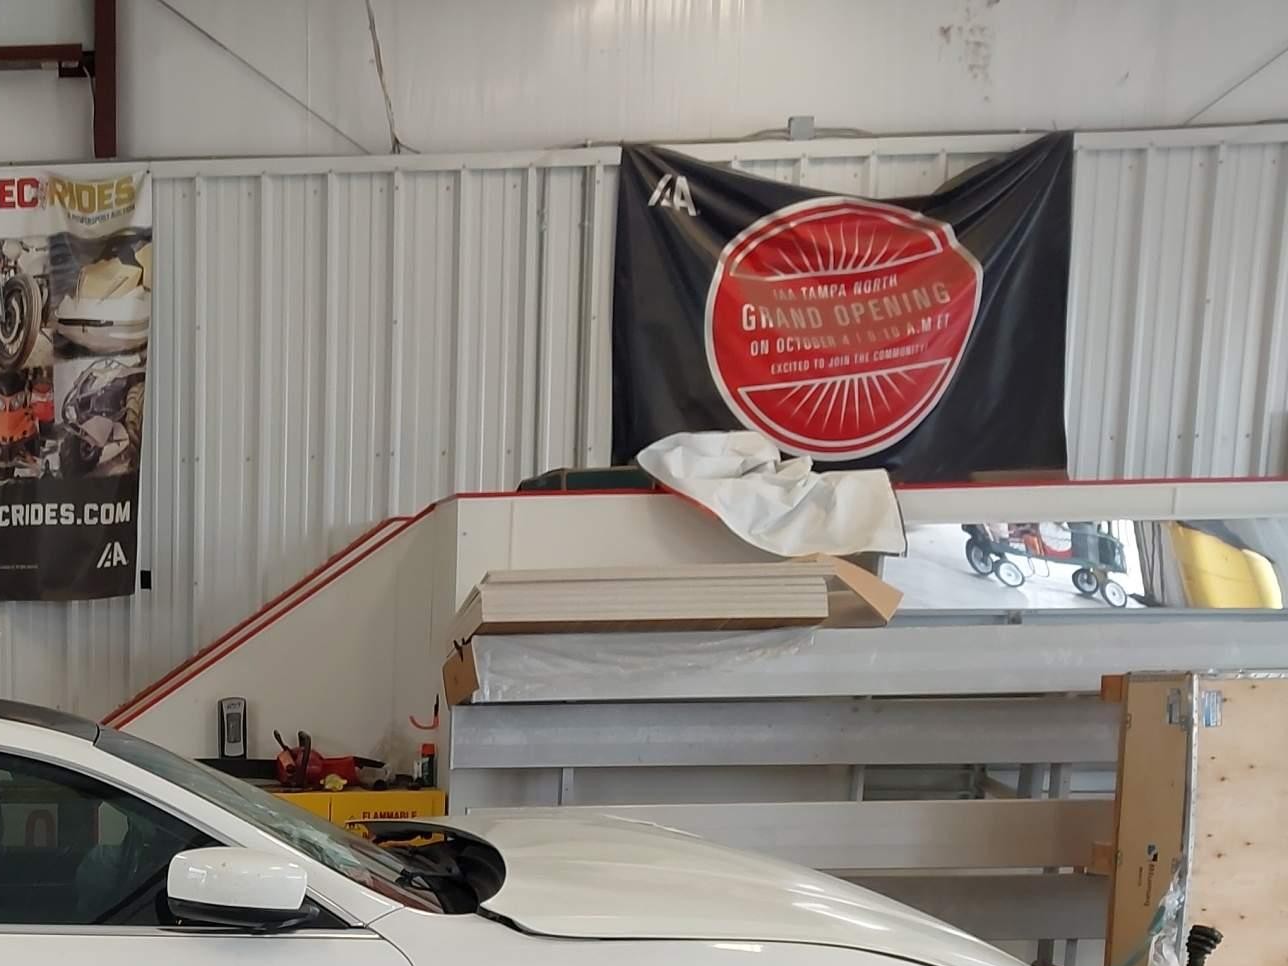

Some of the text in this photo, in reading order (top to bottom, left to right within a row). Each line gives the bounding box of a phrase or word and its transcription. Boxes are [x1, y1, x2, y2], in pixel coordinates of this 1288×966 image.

[800, 284, 846, 300] TAMPA
[853, 274, 898, 295] NORTH
[742, 282, 951, 331] GRAND OPENING
[750, 339, 770, 357] ON
[776, 336, 837, 353] OCTOBER
[814, 358, 825, 370] TO
